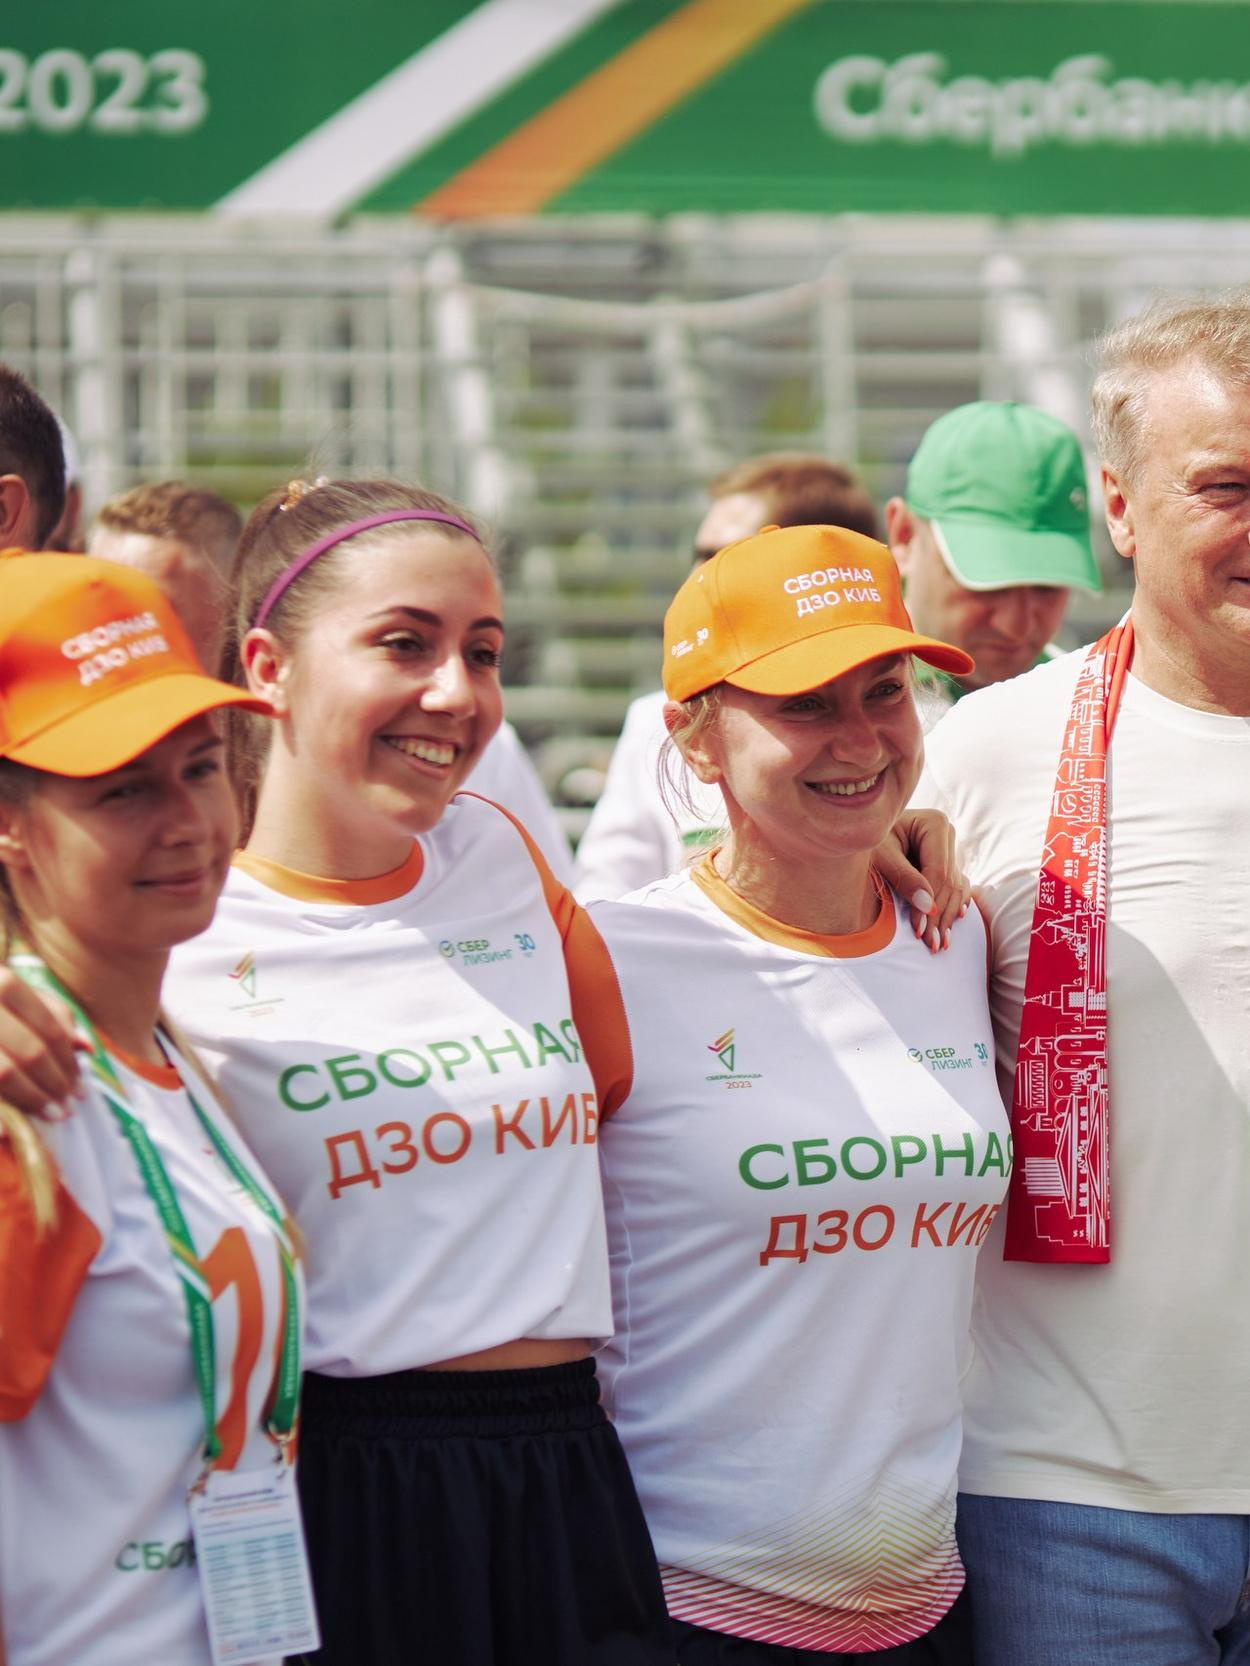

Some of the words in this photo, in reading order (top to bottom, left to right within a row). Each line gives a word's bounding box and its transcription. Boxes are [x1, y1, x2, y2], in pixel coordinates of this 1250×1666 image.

[0, 48, 207, 135] 2023
[783, 567, 875, 594] СБОРНАЯ
[797, 591, 840, 618] ДЗО
[843, 588, 881, 603] КИБ
[457, 940, 488, 952] СБЕР
[514, 934, 535, 951] 30
[463, 949, 512, 966] ЛИЗИНГ
[278, 1018, 580, 1112] СБОРНАЯ
[925, 1047, 956, 1060] СБЕР
[931, 1058, 974, 1070] ЛИЗИНГ
[726, 1081, 752, 1089] 2023
[323, 1111, 472, 1200] ДЗО
[491, 1092, 598, 1155] КИБ
[759, 1204, 895, 1266] ДЗО
